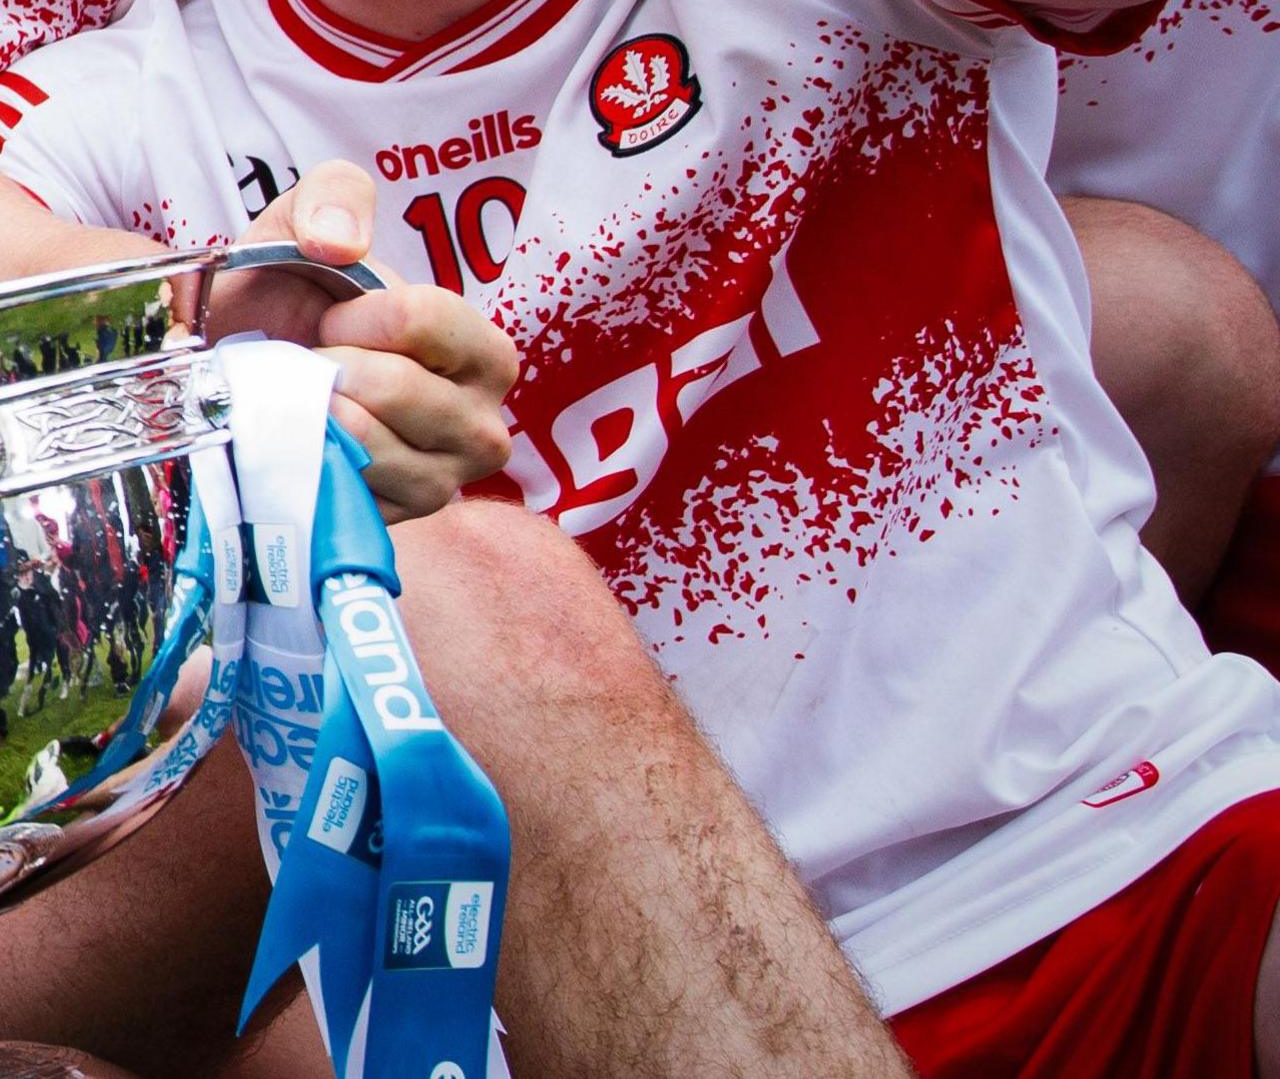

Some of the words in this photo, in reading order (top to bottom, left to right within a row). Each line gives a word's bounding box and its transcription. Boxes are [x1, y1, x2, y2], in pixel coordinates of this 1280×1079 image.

[376, 110, 542, 182] o'neills
[403, 175, 528, 297] 10
[331, 585, 443, 731] land
